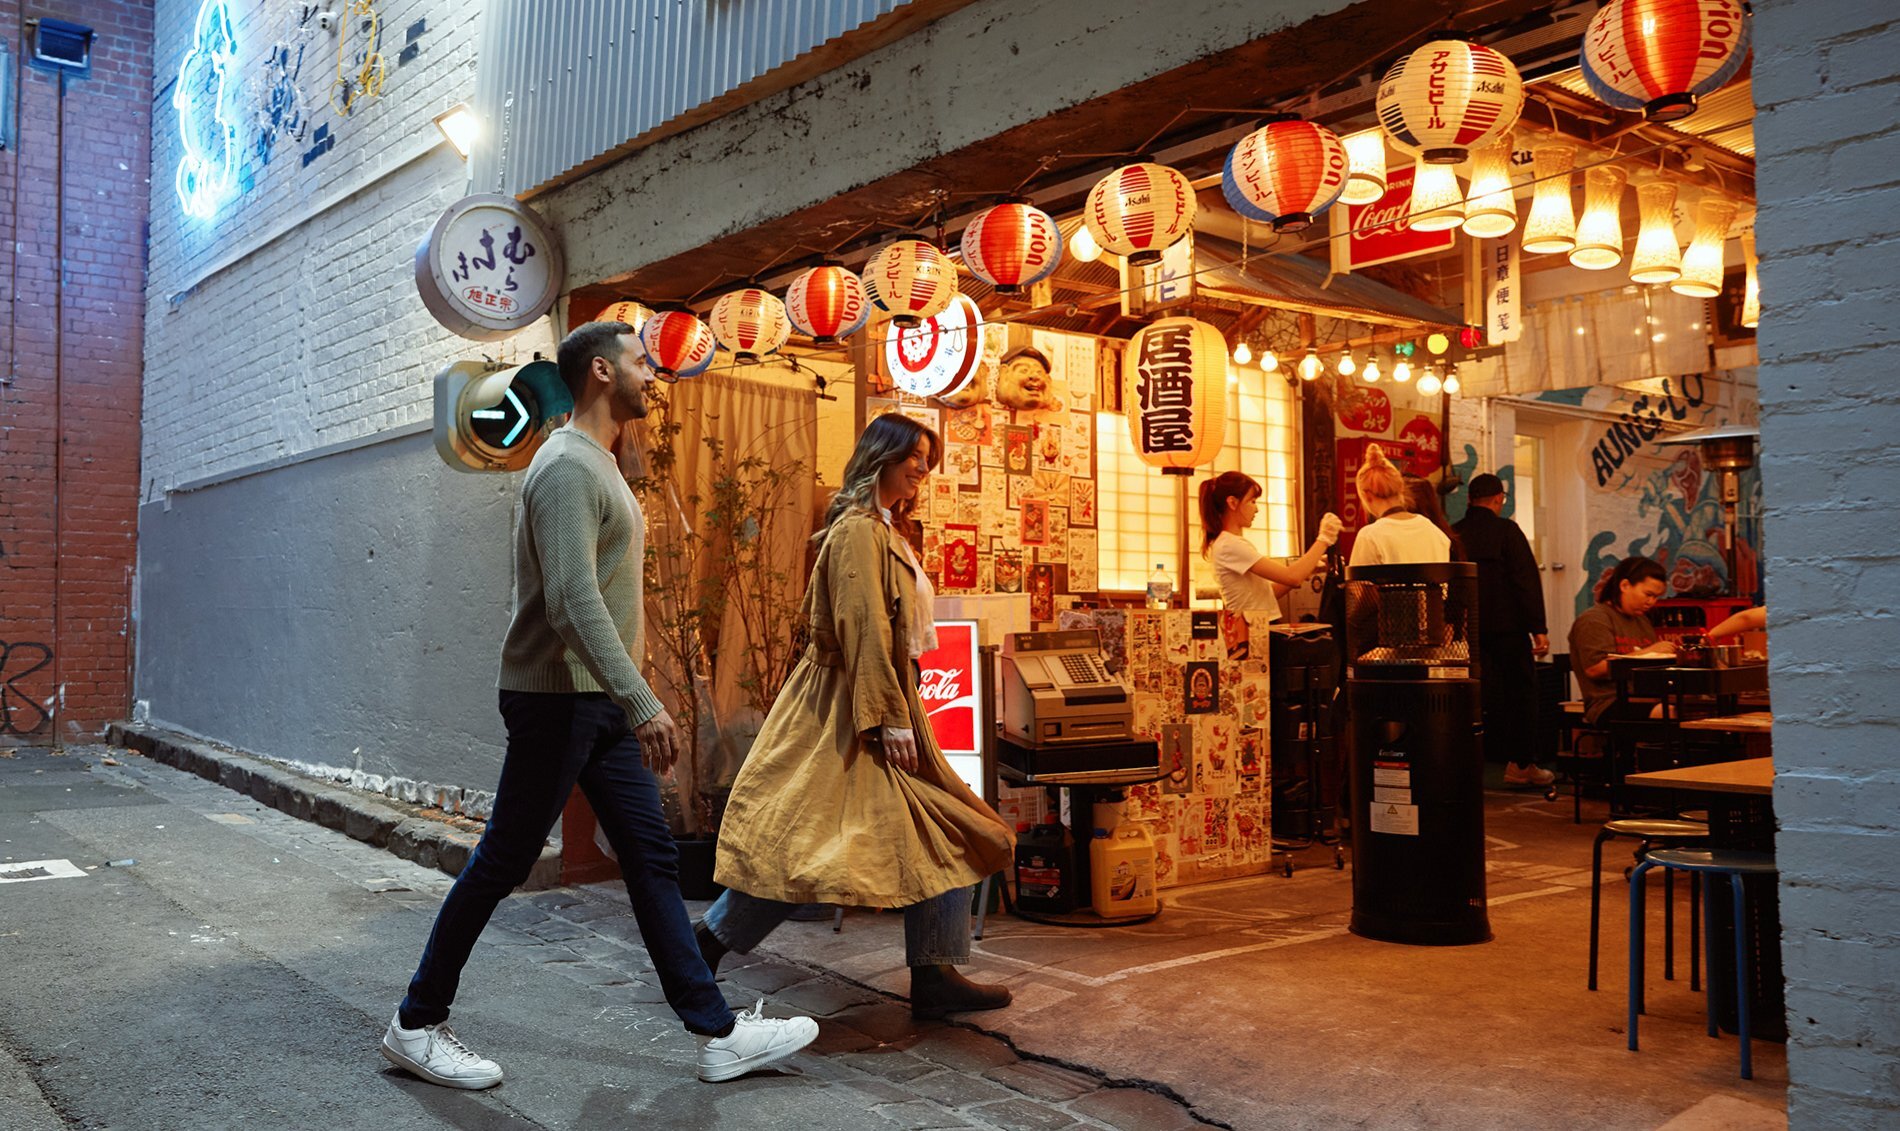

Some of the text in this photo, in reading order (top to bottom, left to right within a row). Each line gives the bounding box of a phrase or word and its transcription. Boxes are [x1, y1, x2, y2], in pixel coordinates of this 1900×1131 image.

[1427, 50, 1451, 130] アサヒビール
[1475, 80, 1506, 95] Asahi
[1124, 193, 1151, 207] Asahi
[1164, 168, 1186, 235] アサヒビール
[886, 246, 904, 300] キリンビール
[915, 264, 941, 276] KIRIN
[467, 288, 513, 312] 旭正宗
[718, 294, 734, 340] キリンビール
[1136, 324, 1194, 454] 居酒屋
[1381, 446, 1402, 457] OTTE
[1343, 457, 1358, 533] LOTTE
